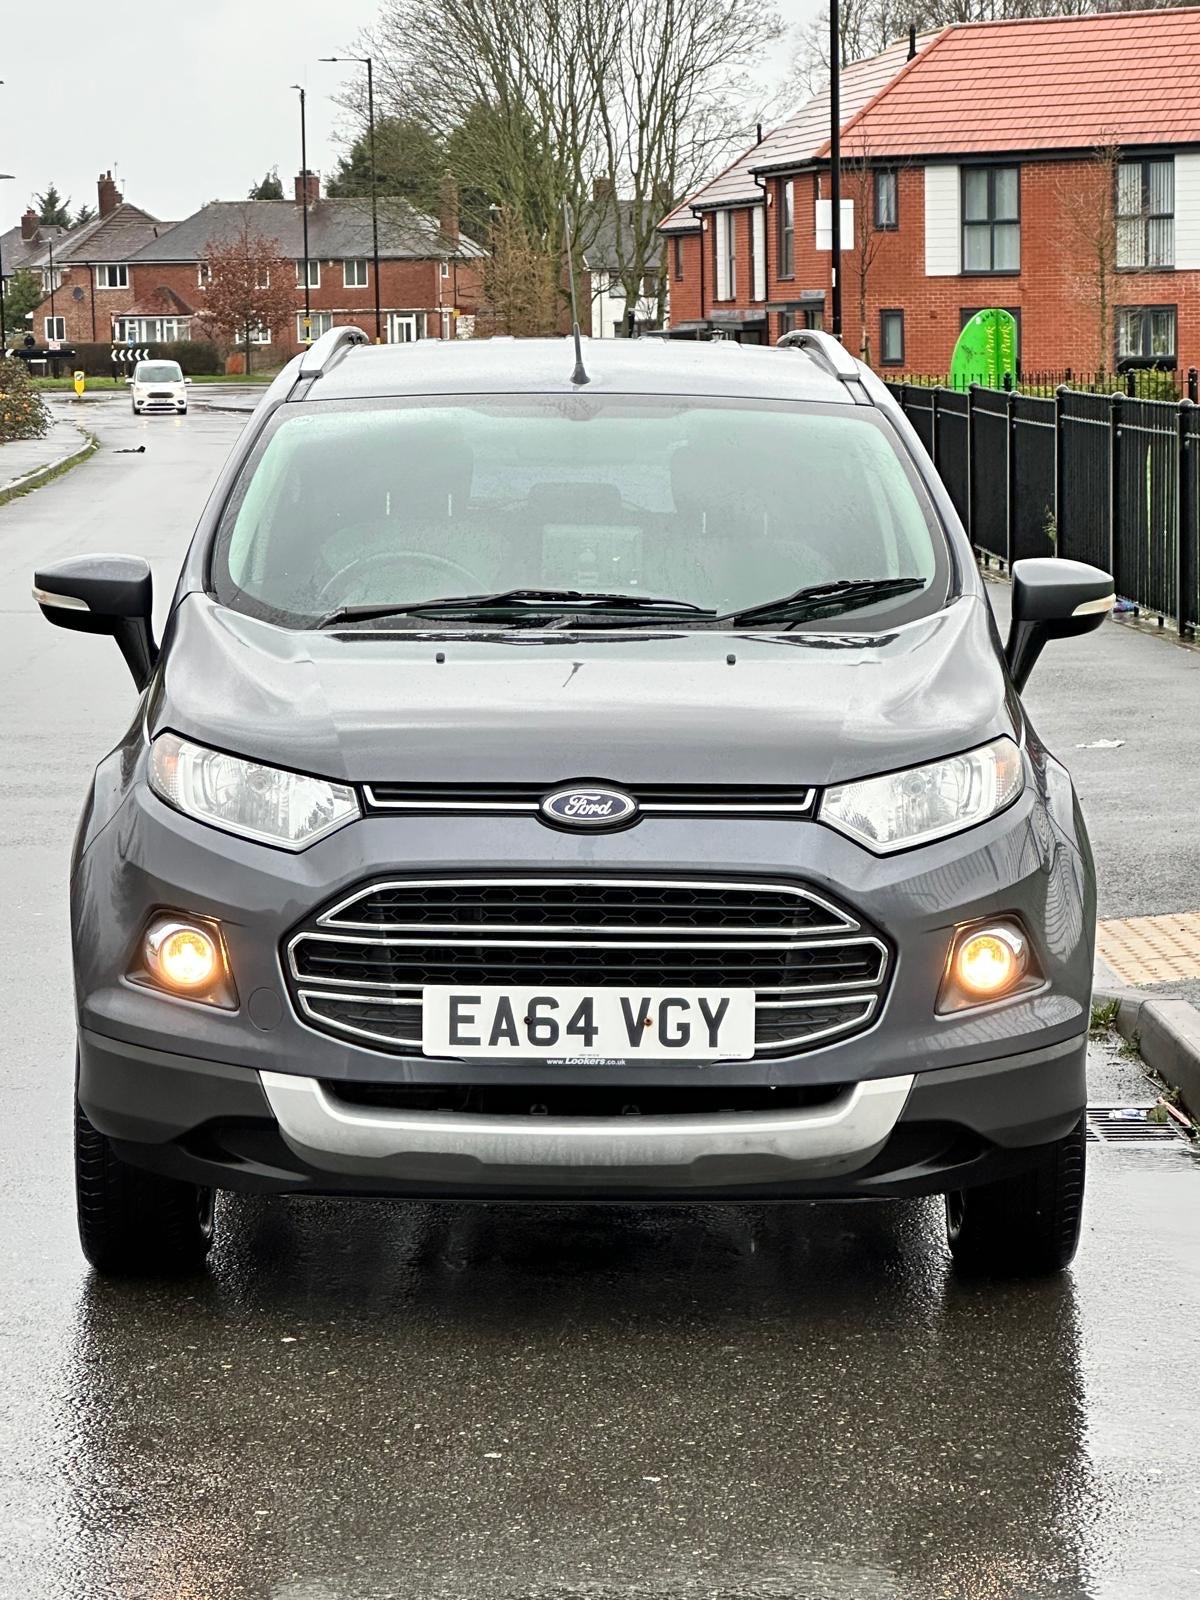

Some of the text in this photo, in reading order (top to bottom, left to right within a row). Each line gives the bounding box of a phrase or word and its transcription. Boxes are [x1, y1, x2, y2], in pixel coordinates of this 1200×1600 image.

[985, 326, 996, 353] Park
[1000, 326, 1012, 353] Park
[564, 794, 614, 815] Ford
[448, 995, 731, 1049] EA64 VGY
[546, 1057, 626, 1065] www.Lookers.co.uk
